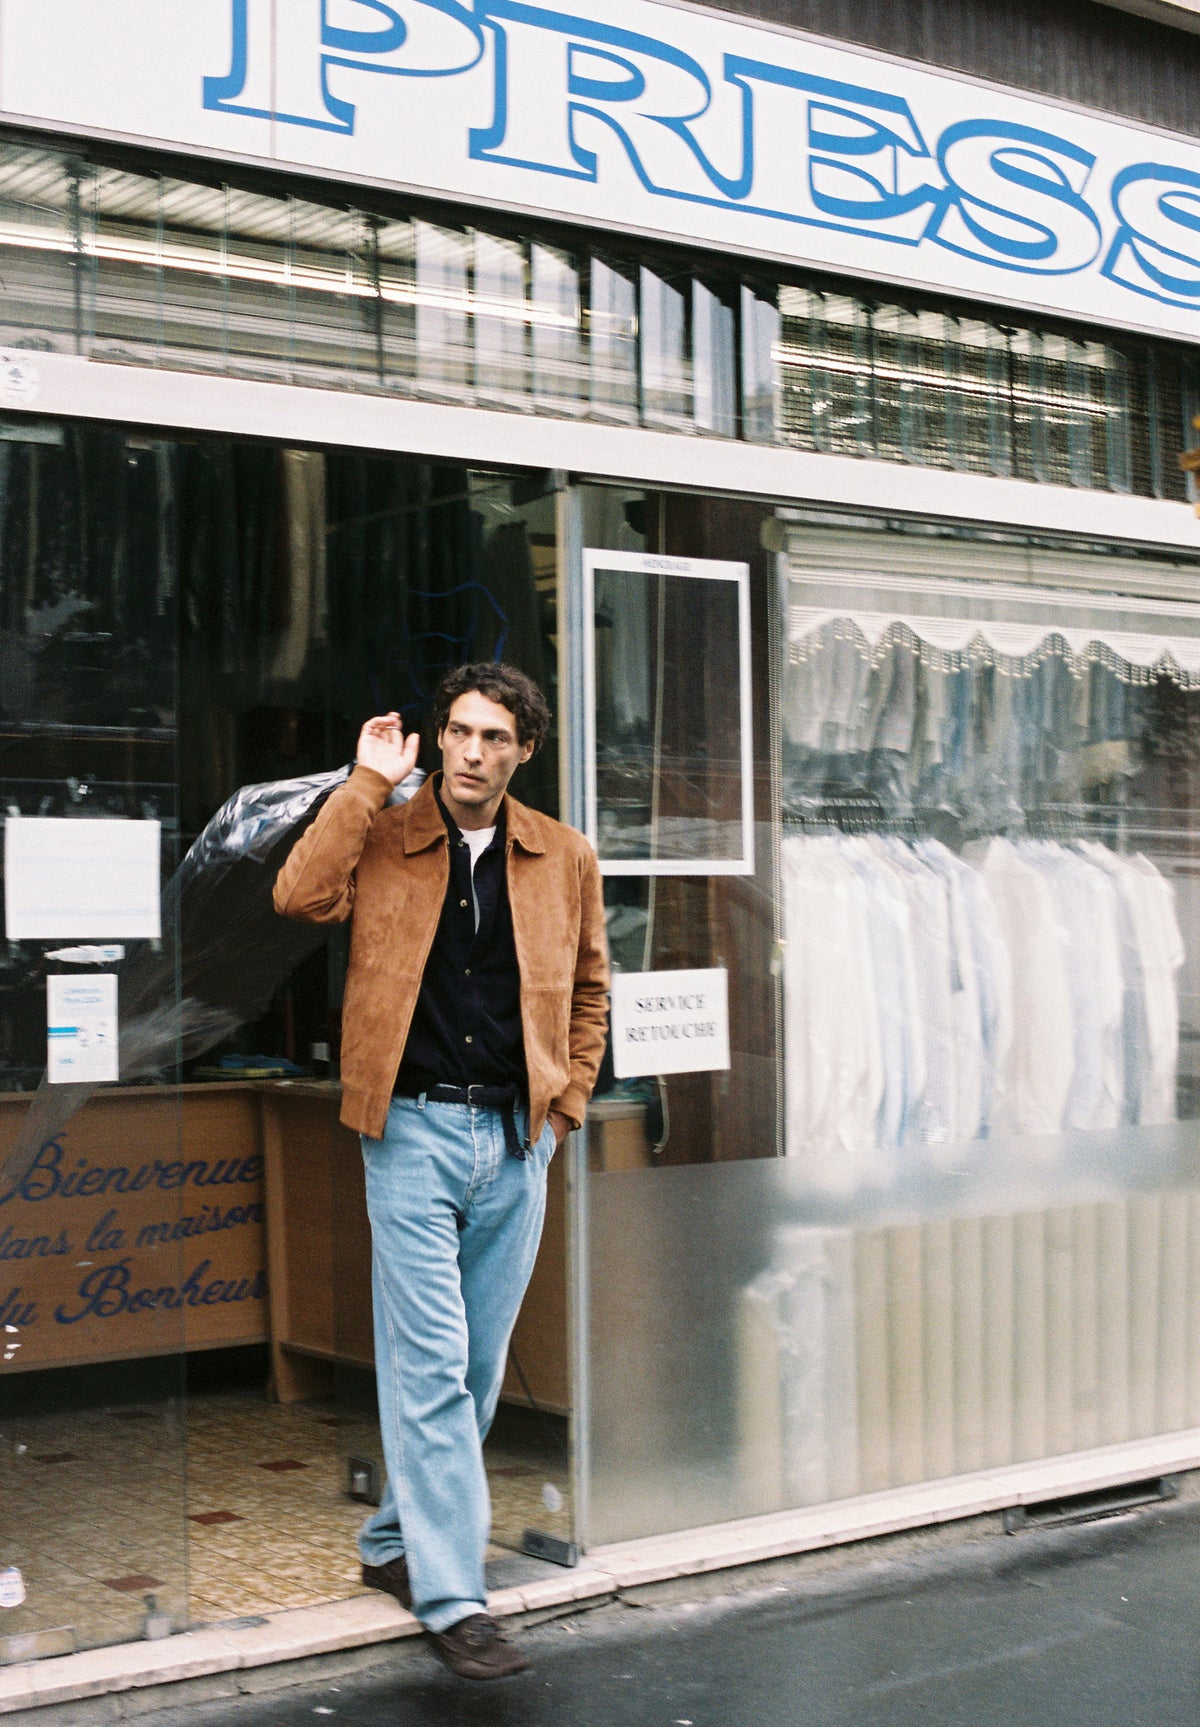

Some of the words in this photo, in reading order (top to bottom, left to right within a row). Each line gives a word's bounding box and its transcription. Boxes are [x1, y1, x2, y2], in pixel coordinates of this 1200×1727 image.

[202, 0, 1200, 311] PRESS
[625, 1021, 717, 1043] RETOUCHE
[634, 994, 708, 1013] SERVICE
[0, 1132, 264, 1204] Bienvenue
[85, 1208, 126, 1252] la
[135, 1203, 265, 1248] maison
[54, 1257, 268, 1325] Bonheur
